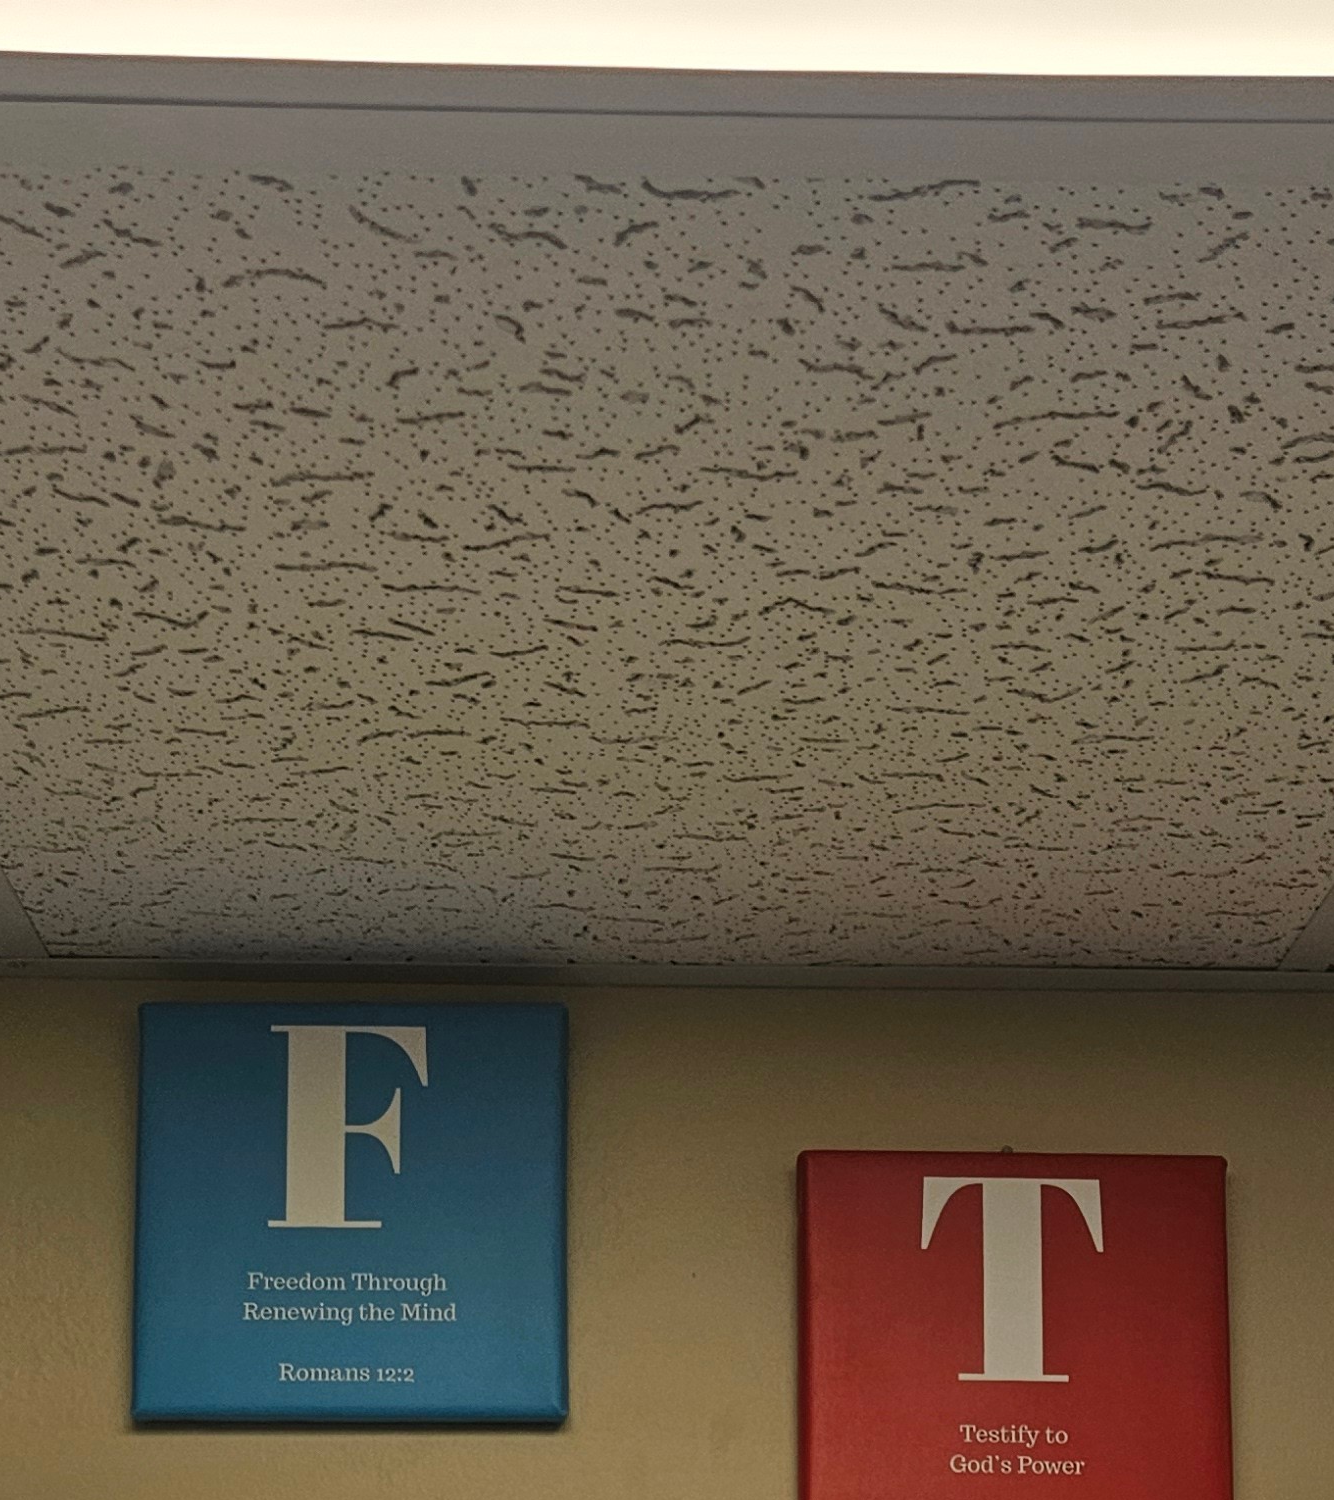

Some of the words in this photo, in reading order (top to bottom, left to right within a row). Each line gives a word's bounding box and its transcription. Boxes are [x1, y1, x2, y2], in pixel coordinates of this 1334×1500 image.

[268, 1025, 428, 1228] F
[248, 1272, 346, 1291] Freedom
[352, 1273, 447, 1296] Through
[921, 1177, 1104, 1382] T
[243, 1303, 353, 1325] Renewing
[359, 1303, 395, 1321] the
[401, 1303, 456, 1321] Mind
[279, 1364, 370, 1382] Romans
[376, 1368, 414, 1382] 12:2
[960, 1425, 1039, 1449] Testify
[1045, 1427, 1069, 1445] to
[949, 1455, 1012, 1475] God's
[1017, 1456, 1085, 1475] Power
